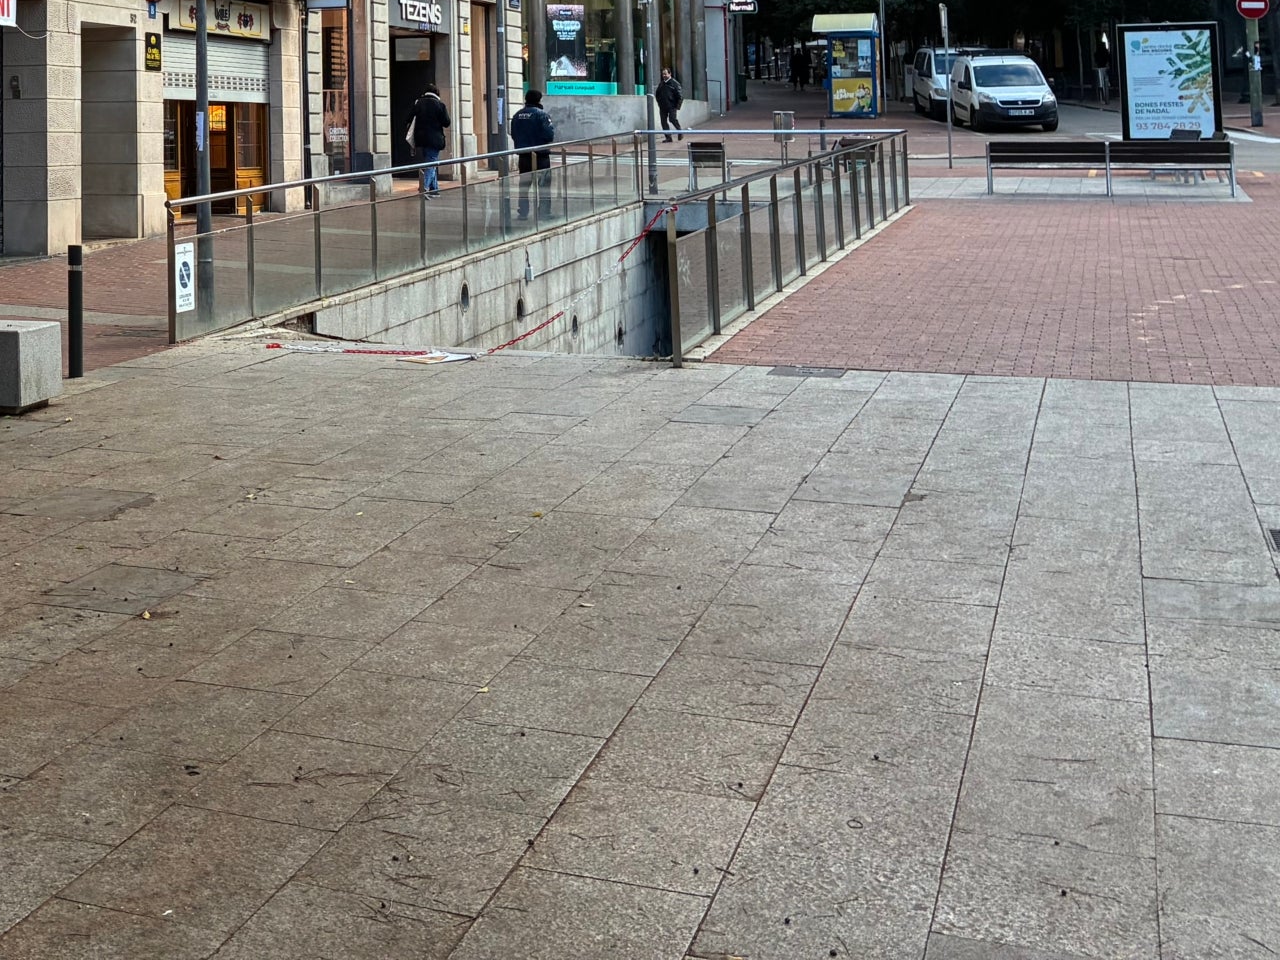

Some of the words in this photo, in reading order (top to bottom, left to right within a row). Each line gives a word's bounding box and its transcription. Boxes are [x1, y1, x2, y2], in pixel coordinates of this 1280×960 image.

[730, 2, 754, 11] Normal
[130, 13, 137, 24] 52
[1151, 122, 1170, 130] 784
